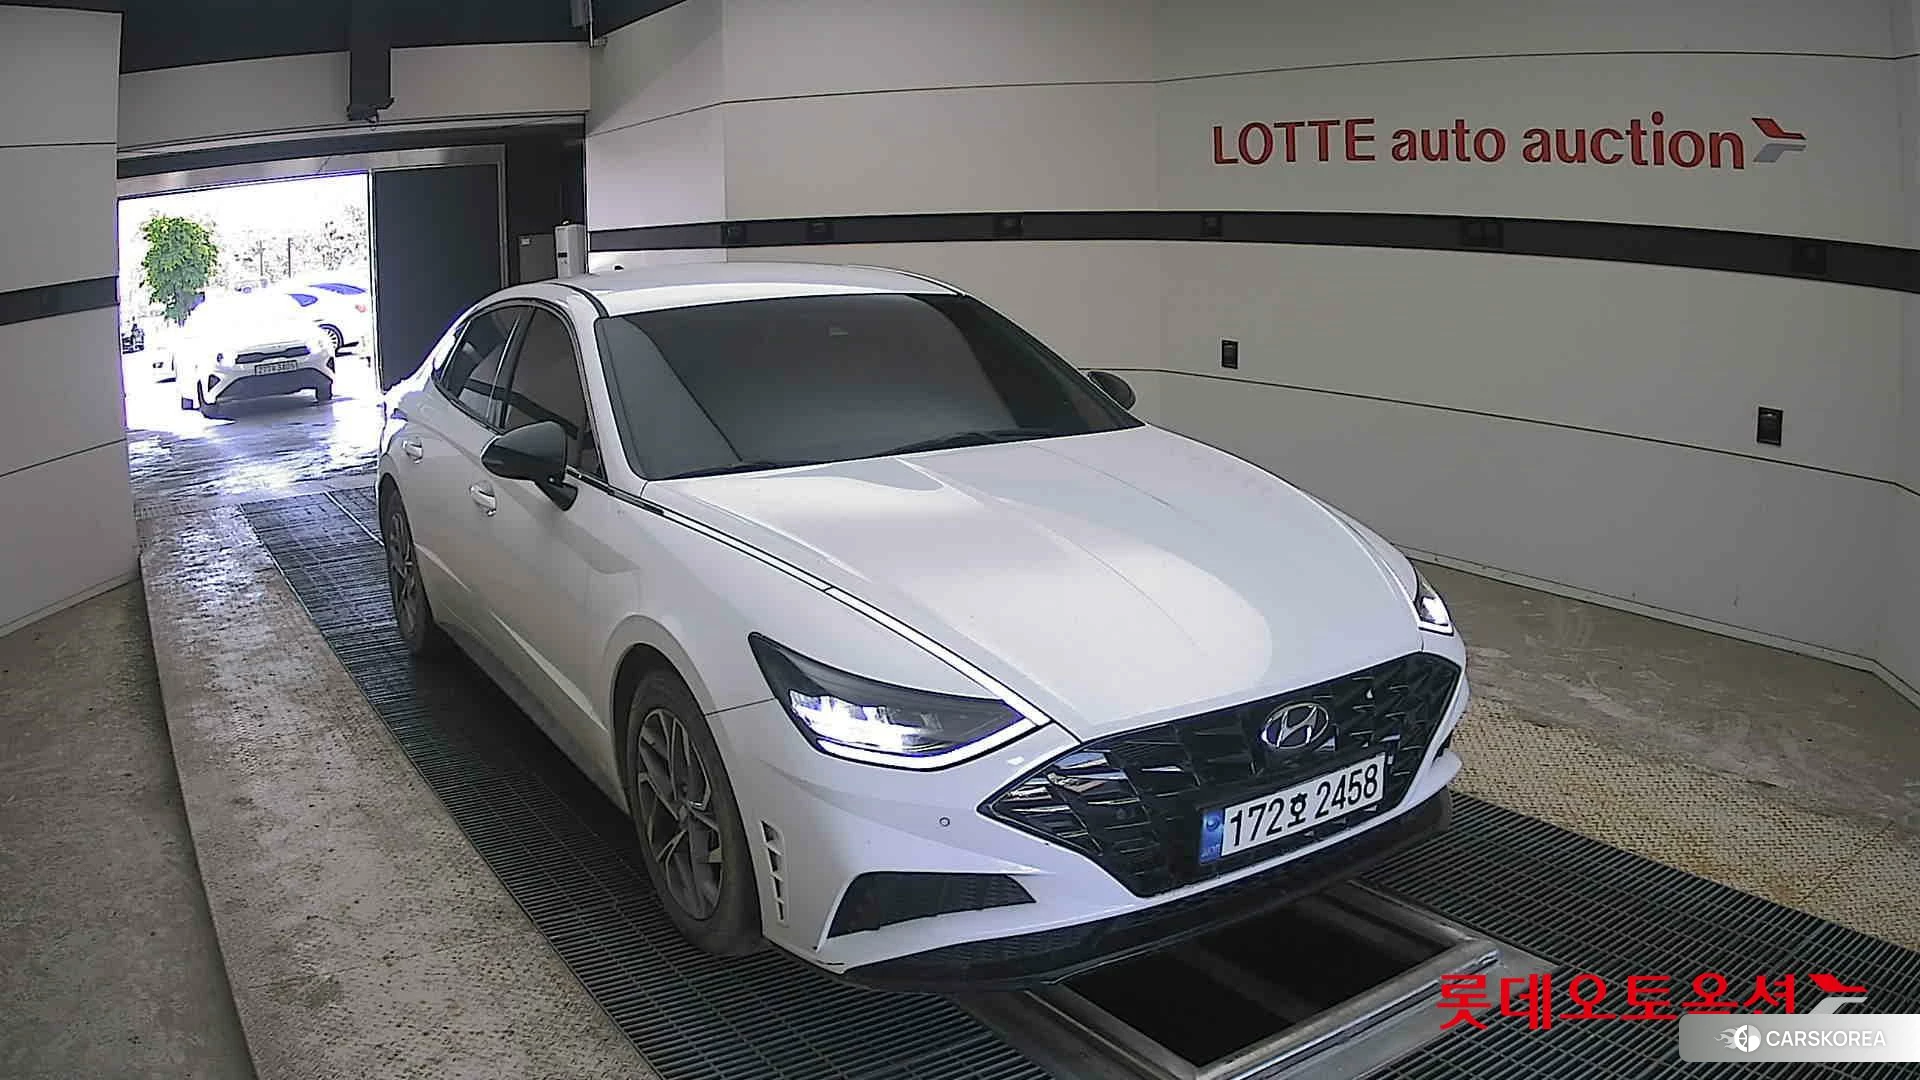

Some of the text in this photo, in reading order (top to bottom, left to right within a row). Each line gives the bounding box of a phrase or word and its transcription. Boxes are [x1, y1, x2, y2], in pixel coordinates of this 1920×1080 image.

[1212, 111, 1745, 170] LOTTE auto auction
[1230, 764, 1378, 847] 172호 2458
